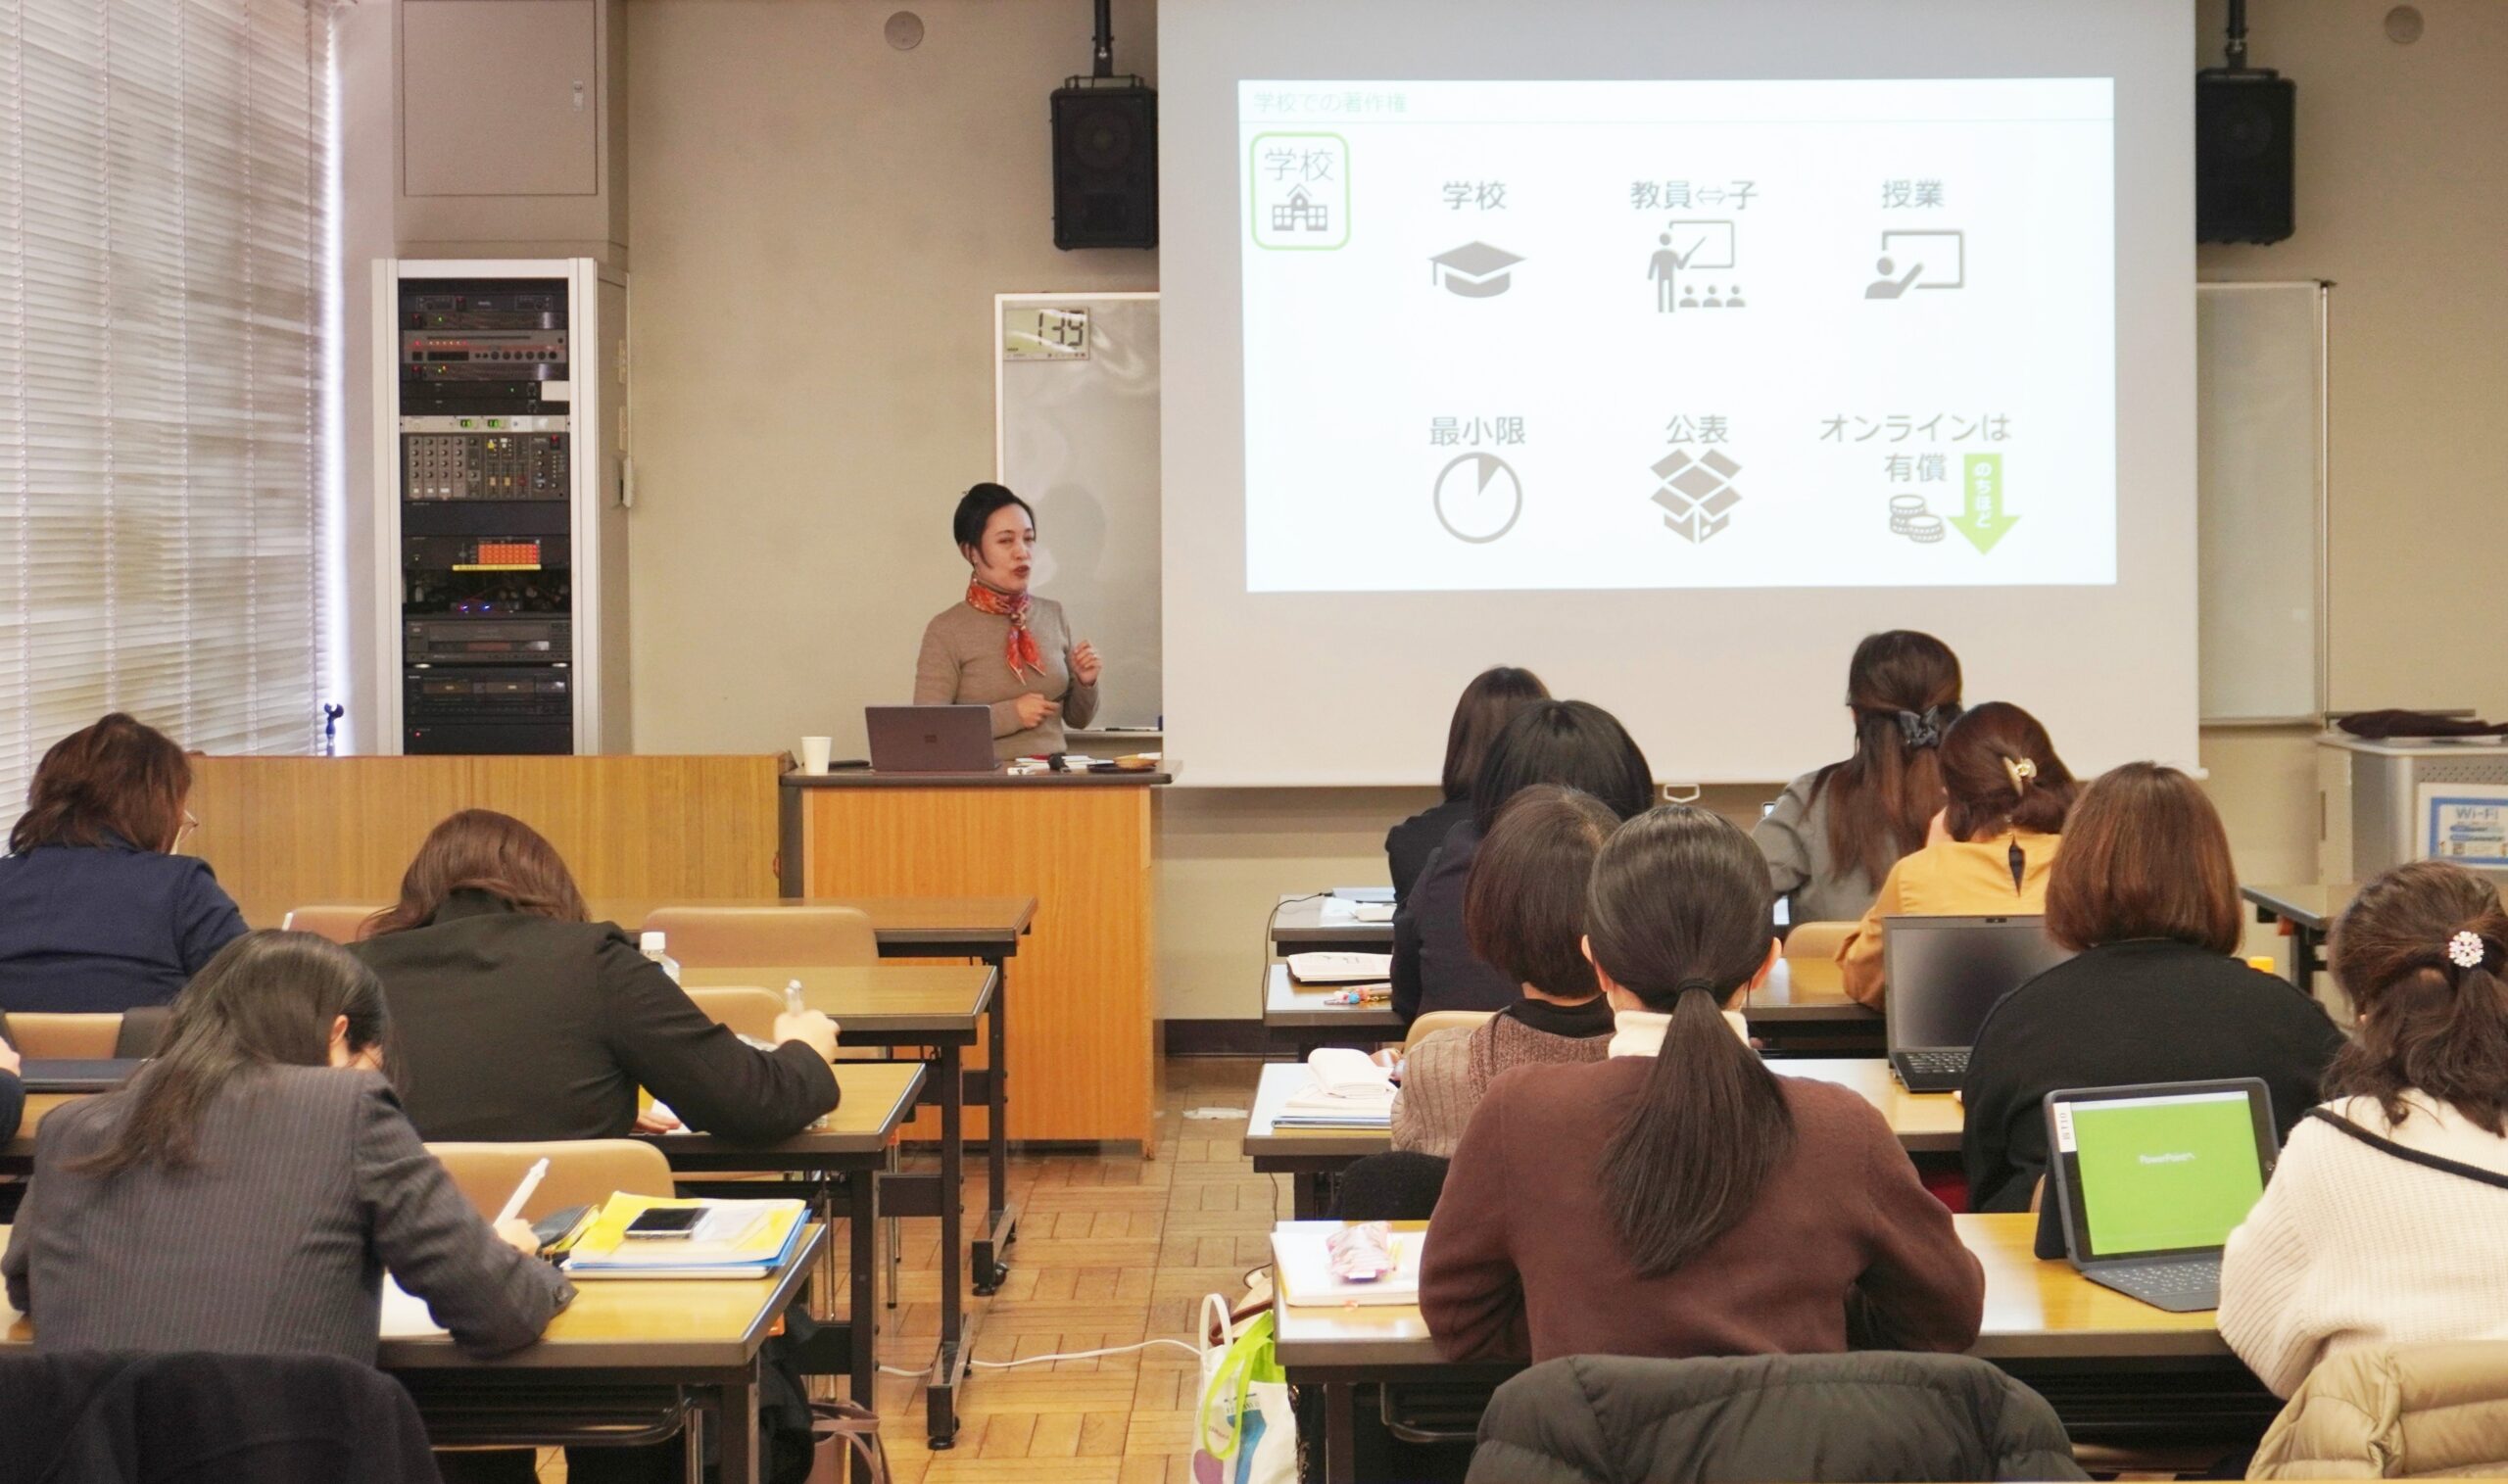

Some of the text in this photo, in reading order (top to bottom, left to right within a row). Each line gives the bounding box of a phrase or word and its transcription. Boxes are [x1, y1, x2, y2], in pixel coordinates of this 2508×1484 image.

[1253, 91, 1408, 114] 学校での著作権
[1264, 148, 1334, 181] 学校
[1442, 180, 1507, 211] 学校
[1881, 180, 1945, 210] 授業
[1429, 415, 1526, 446] 最小限
[1665, 414, 1729, 445] 公表
[1819, 413, 2011, 443] オンラインは
[1885, 454, 1947, 483] 有償
[1973, 461, 1994, 530] のちほど
[2455, 806, 2499, 820] Wi-Fi
